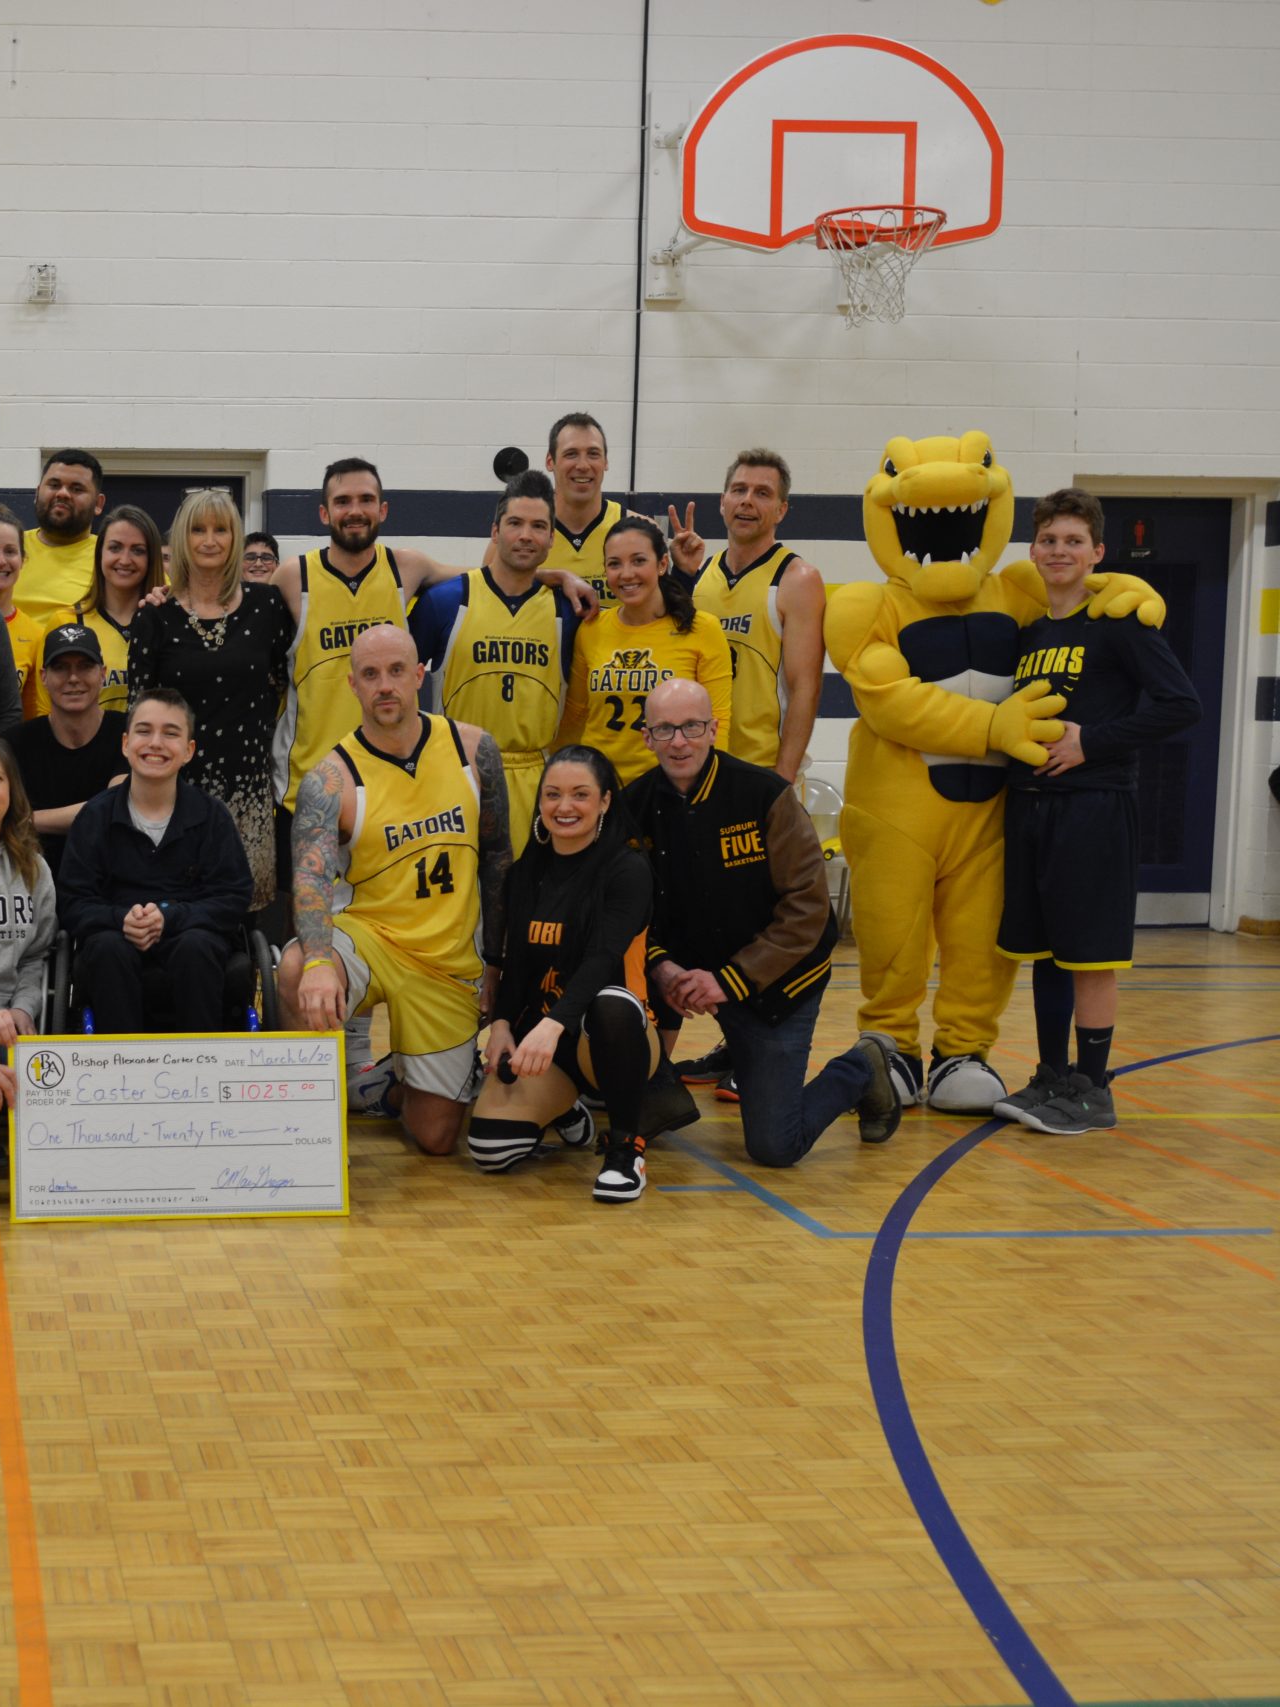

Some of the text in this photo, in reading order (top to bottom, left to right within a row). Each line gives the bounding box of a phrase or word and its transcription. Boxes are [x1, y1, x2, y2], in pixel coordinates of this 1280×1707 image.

[473, 640, 549, 667] GATORS
[1014, 646, 1085, 681] GATORS
[501, 674, 514, 702] 8
[604, 695, 646, 732] 22
[384, 805, 465, 852] GATORS
[720, 820, 757, 835] SUDBURY
[720, 830, 765, 860] FIVE
[724, 854, 767, 868] BASKETBALL
[415, 851, 455, 899] 14
[72, 1051, 218, 1068] Bishop Alexander Carter CSS
[250, 1048, 296, 1065] March
[56, 1089, 71, 1097] THE
[76, 1071, 209, 1102] Easter Seals
[222, 1085, 232, 1100] $
[56, 1098, 67, 1106] OF
[28, 1122, 62, 1146] One
[66, 1119, 140, 1145] Thousand
[152, 1121, 204, 1148] Twenty
[211, 1121, 239, 1141] Five
[295, 1137, 332, 1145] DOLLARS
[29, 1185, 46, 1193] FOR
